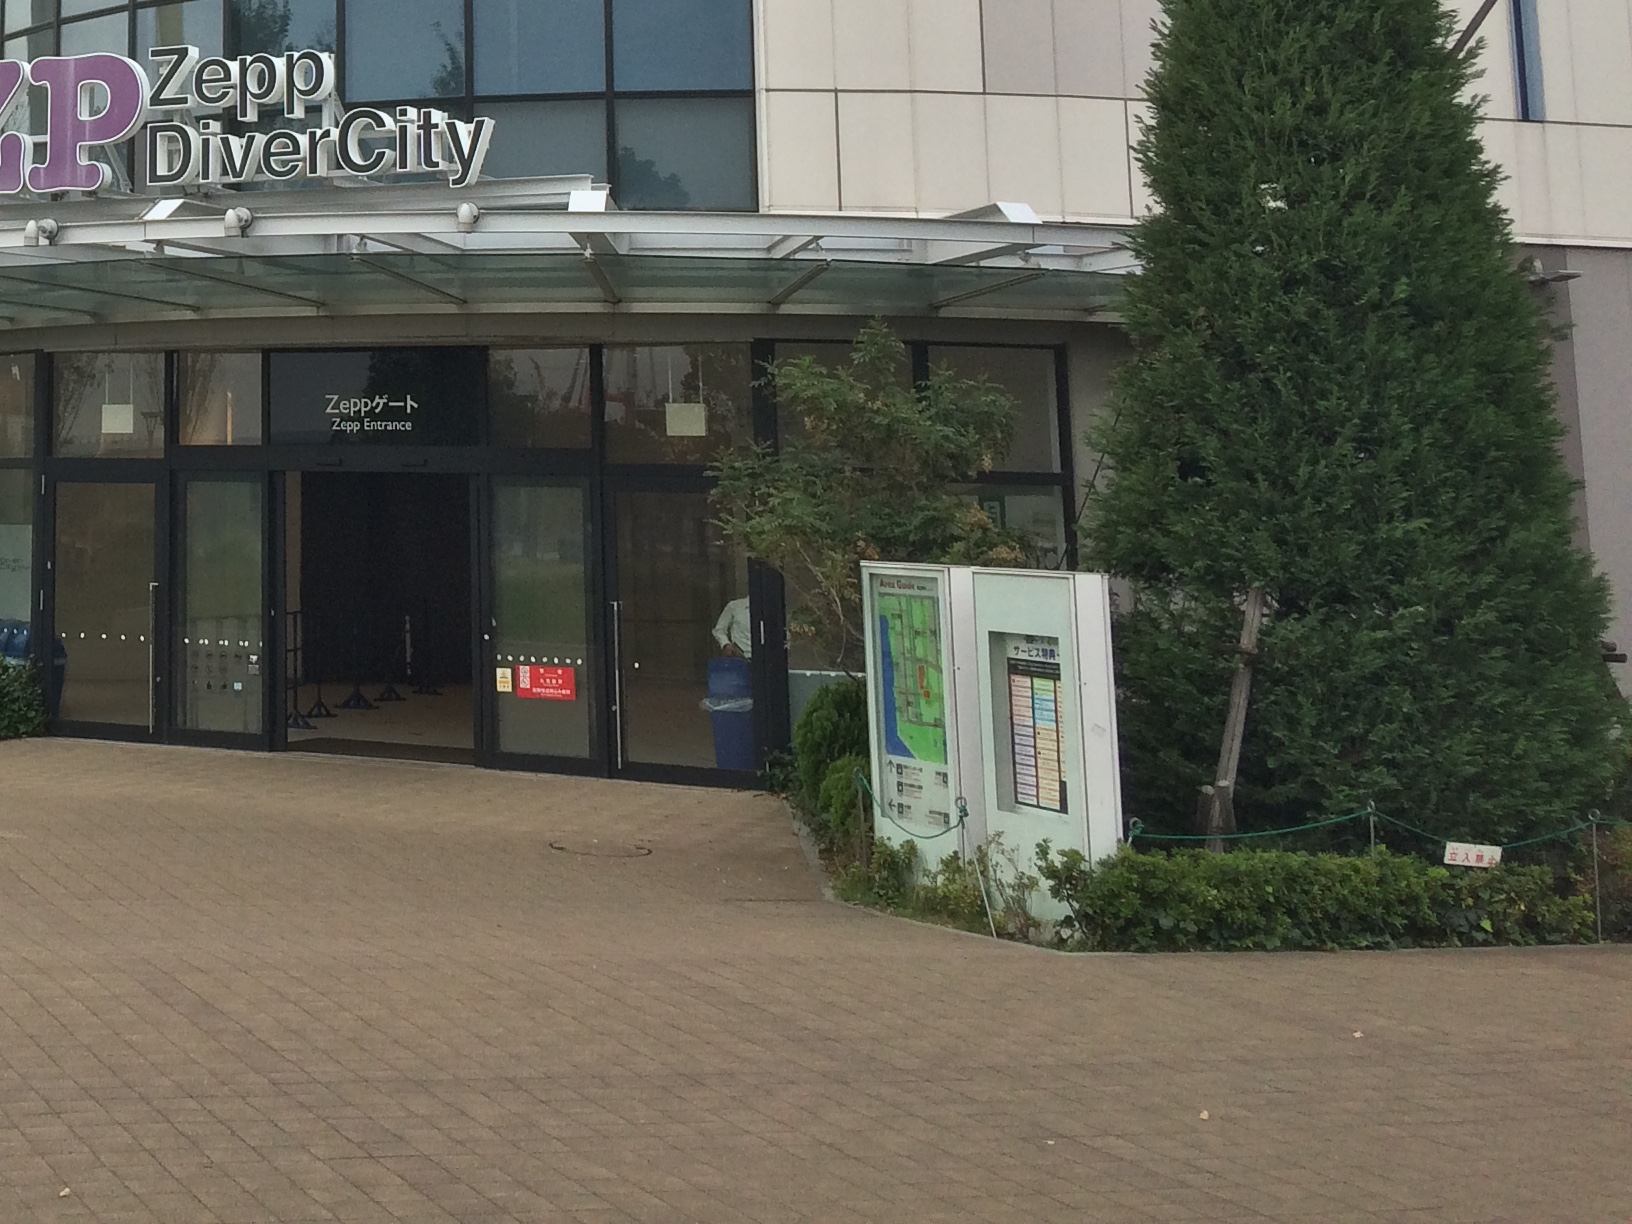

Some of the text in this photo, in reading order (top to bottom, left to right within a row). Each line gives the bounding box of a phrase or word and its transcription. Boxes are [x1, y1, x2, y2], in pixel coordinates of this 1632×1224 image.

[148, 45, 335, 122] Zepp
[146, 107, 494, 188] DiverCity
[325, 394, 419, 417] Zeppゲート
[331, 417, 412, 434] Zepp Entrance
